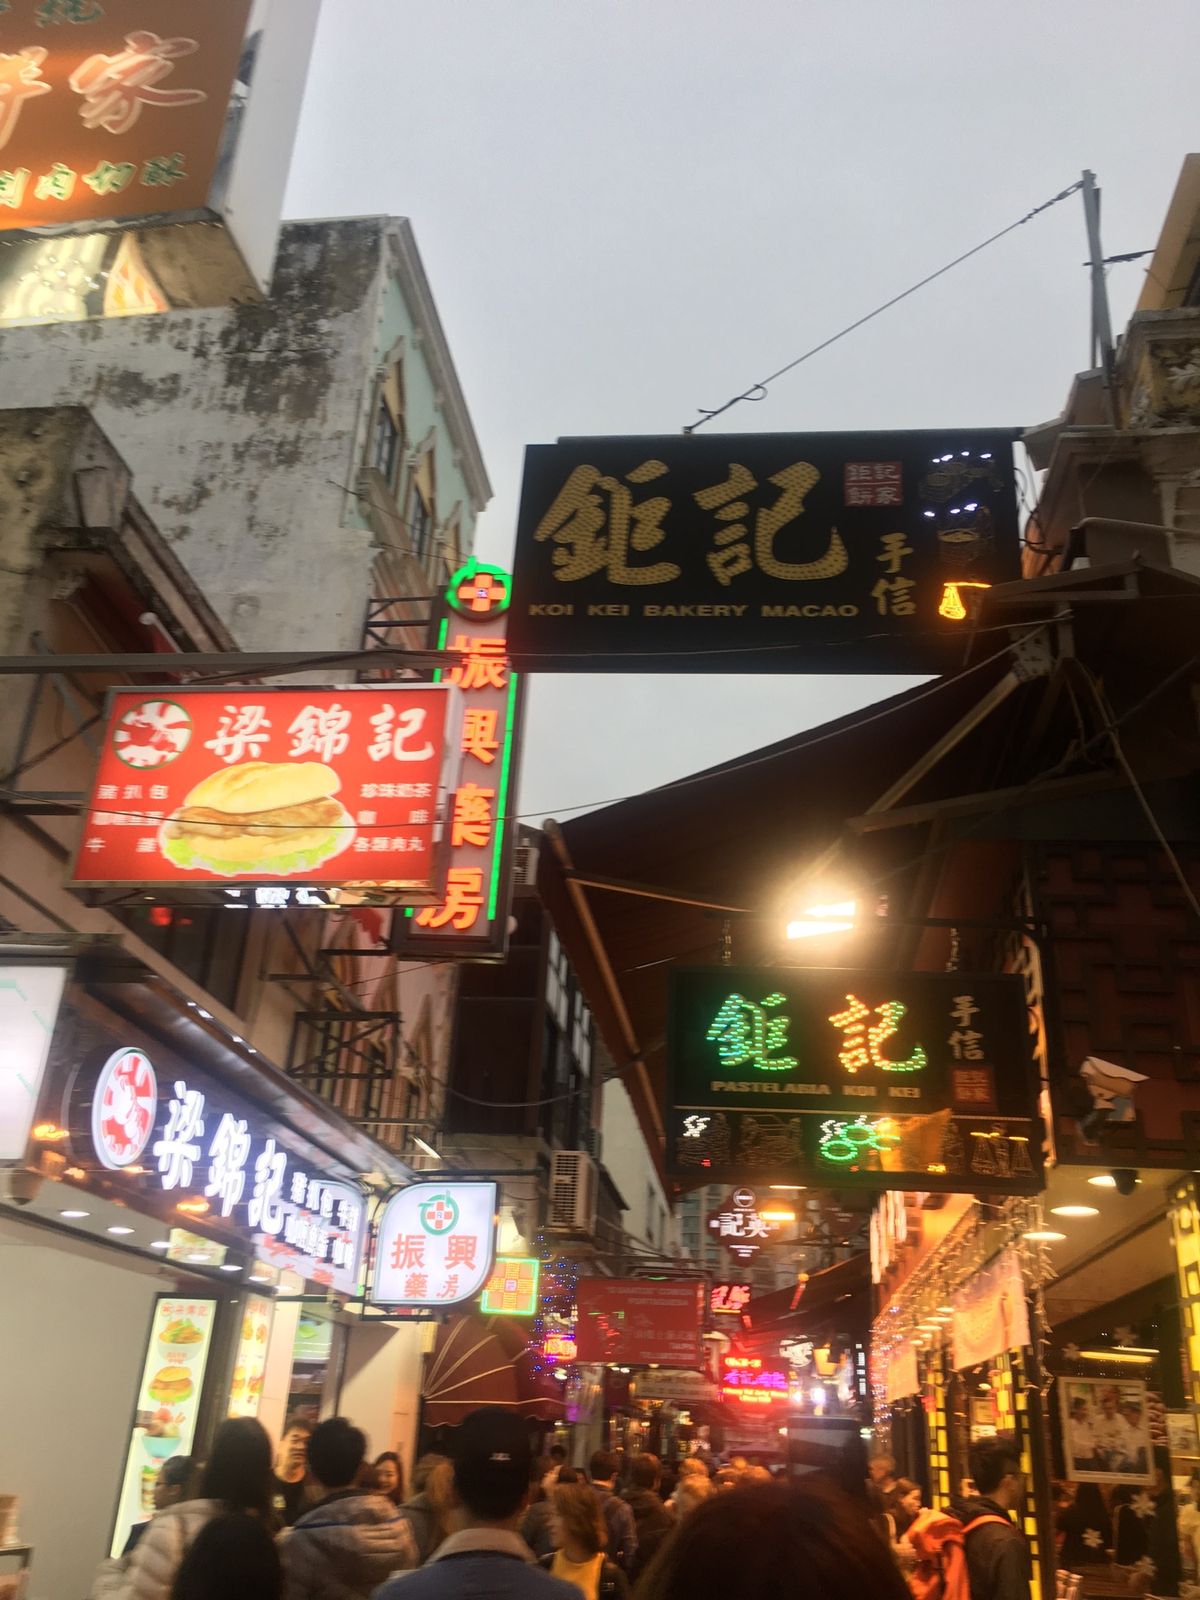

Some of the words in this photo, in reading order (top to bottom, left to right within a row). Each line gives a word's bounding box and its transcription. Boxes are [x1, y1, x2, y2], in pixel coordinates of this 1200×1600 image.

[533, 459, 849, 585] 鉅記
[870, 532, 917, 616] 手信
[529, 604, 574, 616] KOI
[587, 604, 630, 616] KEI
[643, 604, 747, 617] BAKERY
[761, 604, 860, 617] MACAO
[204, 702, 435, 763] 梁錦記
[947, 995, 984, 1060] 手信
[842, 1085, 877, 1096] KOI
[888, 1086, 921, 1098] KEI
[153, 1080, 288, 1235] 梁錦記
[391, 1232, 478, 1271] 振興
[404, 1272, 460, 1299] 藥房
